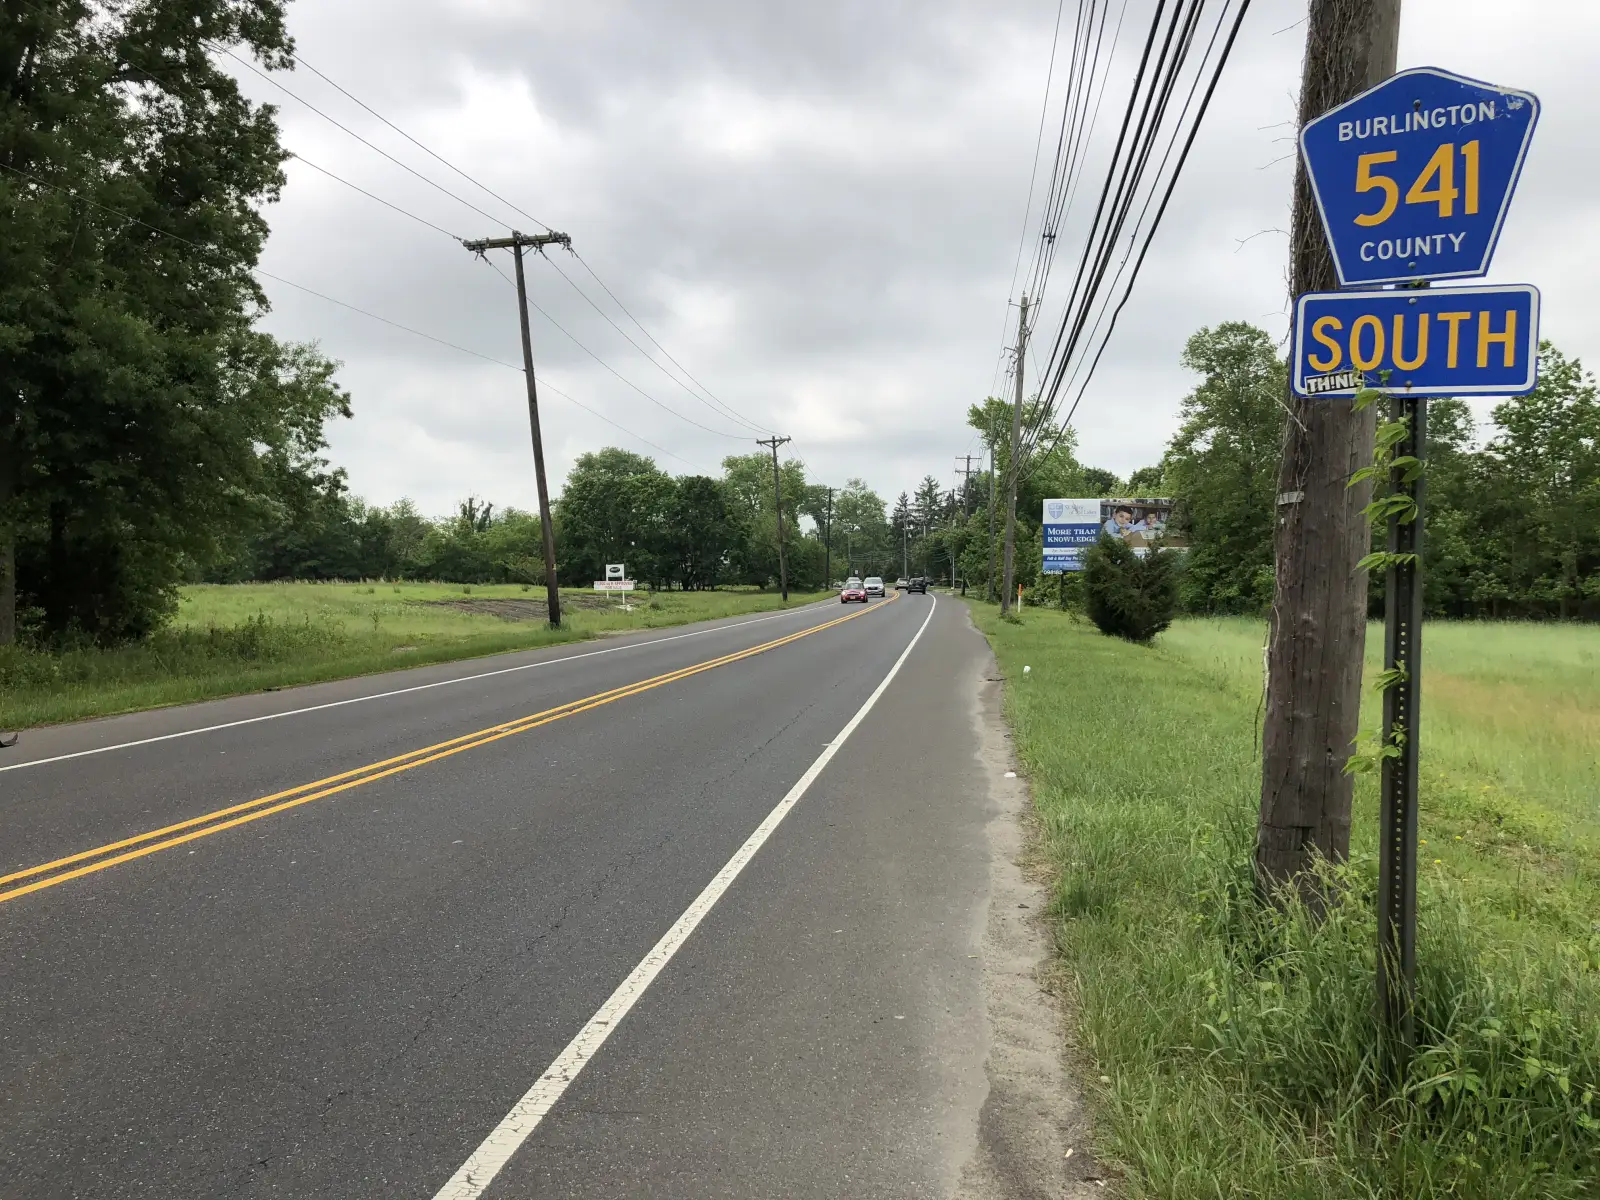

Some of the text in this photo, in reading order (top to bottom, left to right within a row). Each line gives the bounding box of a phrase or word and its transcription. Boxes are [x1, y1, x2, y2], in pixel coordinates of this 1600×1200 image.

[1338, 101, 1495, 142] BURLINGTON
[1353, 140, 1480, 227] 541
[1360, 231, 1467, 262] COUNTY
[1307, 310, 1517, 372] SOUTH
